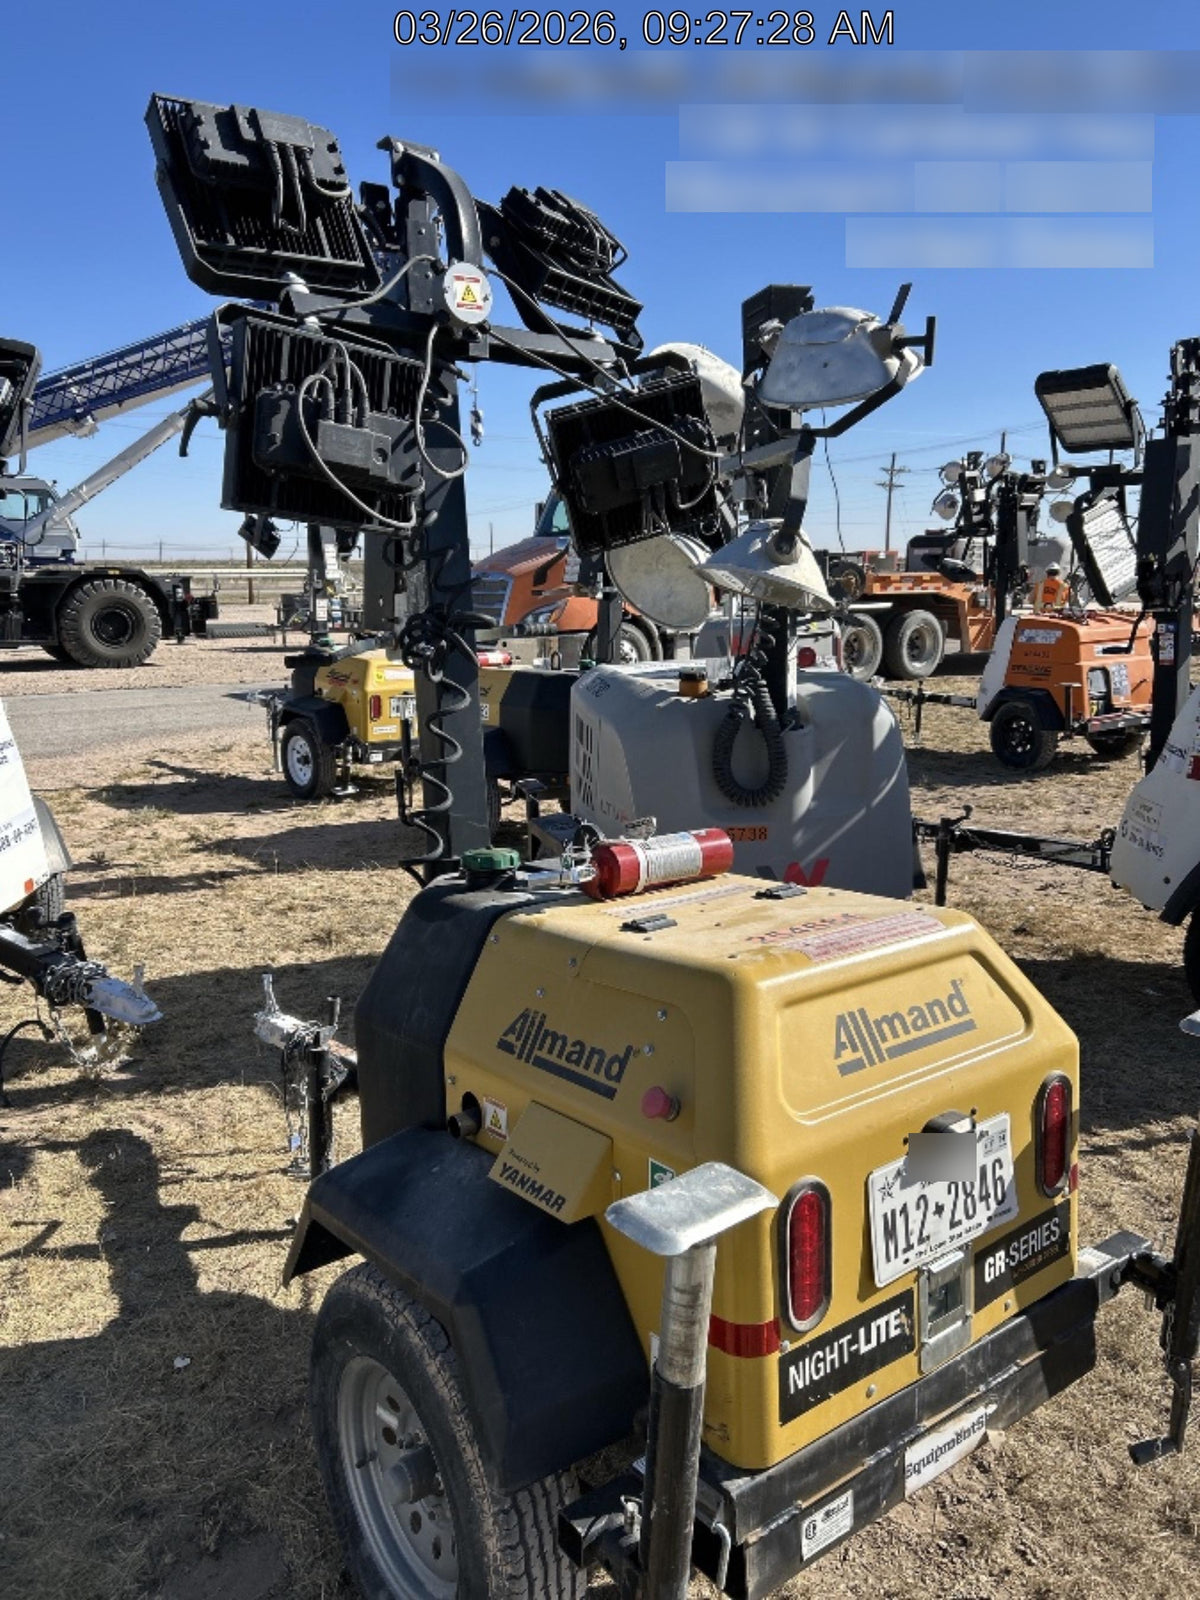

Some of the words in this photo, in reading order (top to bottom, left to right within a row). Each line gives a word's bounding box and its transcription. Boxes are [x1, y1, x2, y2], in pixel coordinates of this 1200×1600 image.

[500, 1007, 634, 1084] Allmand
[834, 979, 971, 1067] Allmand
[499, 1162, 566, 1213] YANMAR
[947, 1158, 1006, 1231] 2846
[788, 1306, 902, 1395] NIGHT-LITE
